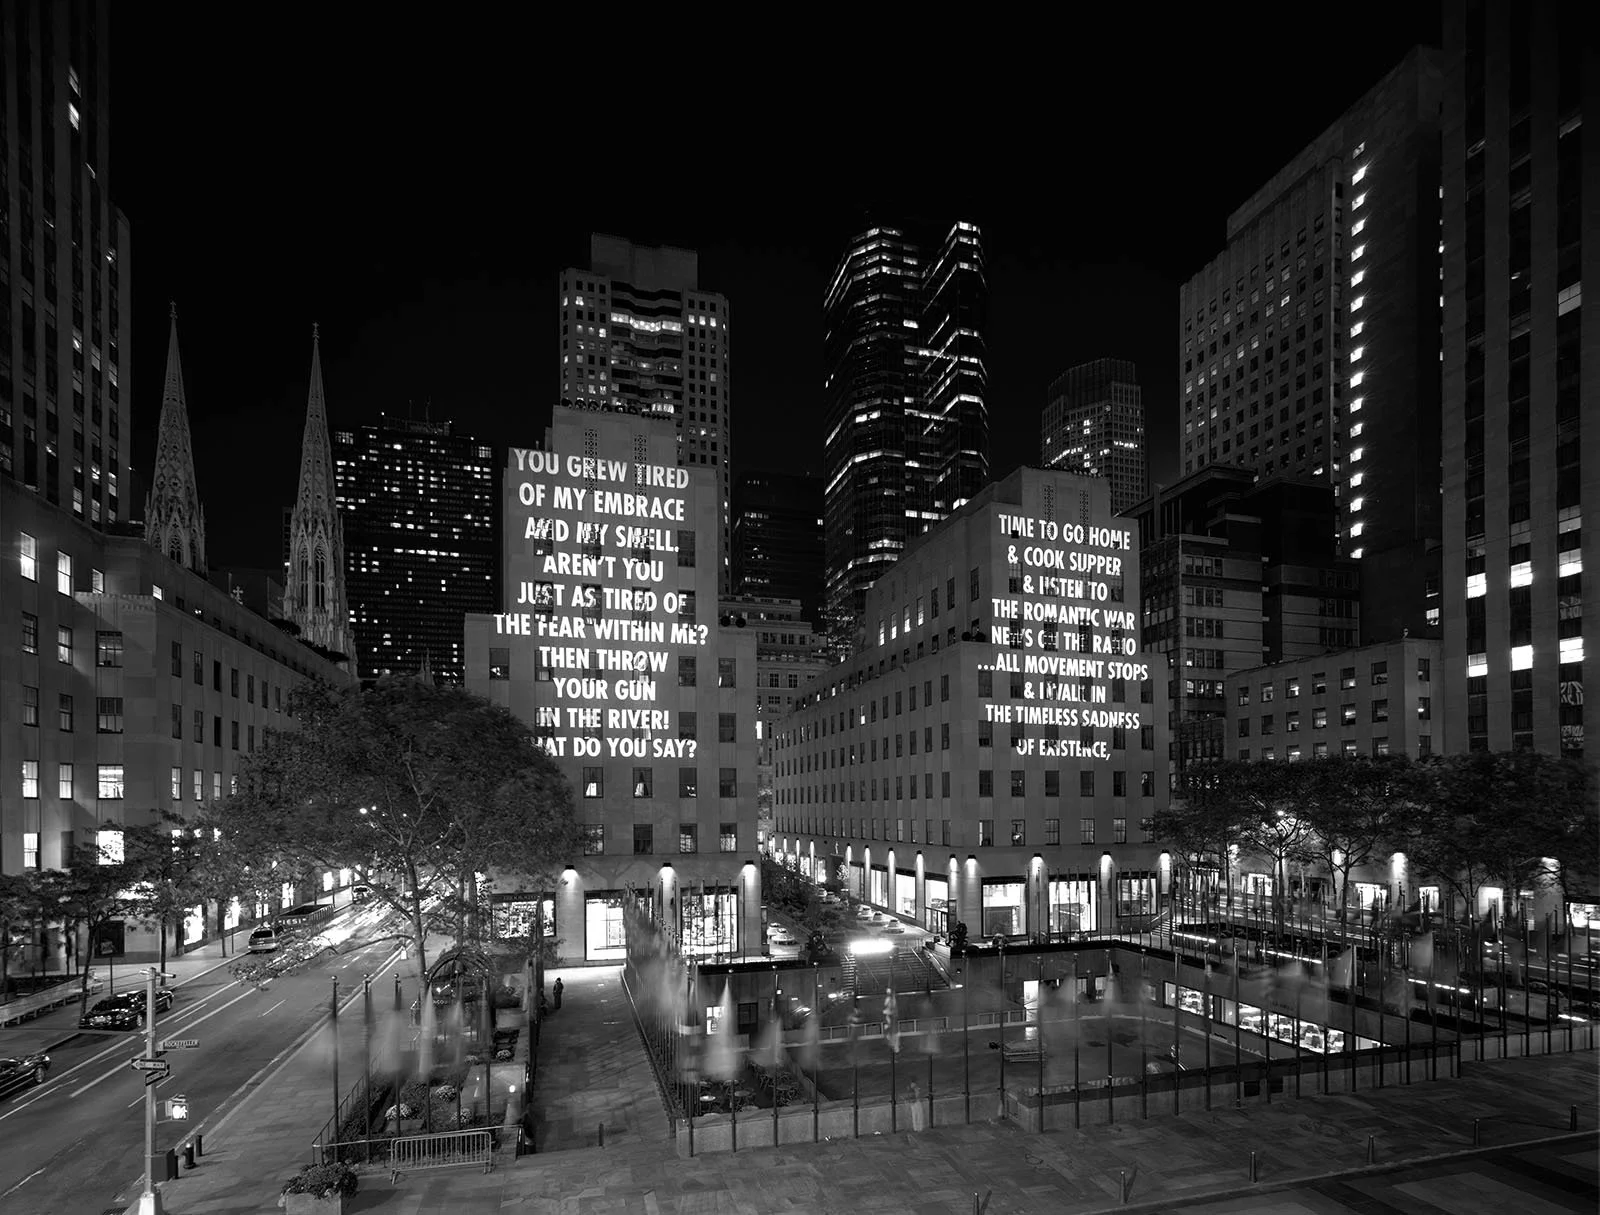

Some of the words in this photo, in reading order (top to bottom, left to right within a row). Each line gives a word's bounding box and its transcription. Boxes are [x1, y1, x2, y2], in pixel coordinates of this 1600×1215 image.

[514, 449, 559, 475] YOU
[567, 455, 628, 482] GREW
[634, 463, 689, 489] TIRED
[519, 482, 546, 506] OF
[553, 486, 587, 511] MY
[594, 490, 685, 521] EMBRACE
[524, 517, 569, 542] AND
[576, 521, 609, 545] MY
[615, 525, 680, 553] SMELL.
[998, 514, 1034, 538] TIME
[1039, 519, 1058, 541] TO
[1063, 523, 1084, 544] GO
[1089, 527, 1131, 550] HOME
[543, 552, 616, 578] AREN'T
[622, 557, 664, 582] YOU
[1007, 545, 1019, 564] &
[1024, 546, 1065, 570] COOK
[1069, 552, 1122, 576] SUPPER
[517, 581, 565, 606] JUST
[571, 585, 597, 608] AS
[603, 587, 657, 612] TIRED
[663, 592, 687, 614] OF
[1023, 574, 1035, 594] &
[1088, 581, 1108, 602] TO
[991, 598, 1019, 619] THE
[1023, 601, 1100, 627] ROMANTIC
[1103, 609, 1135, 630] WAR
[493, 612, 531, 635] THE
[537, 614, 586, 638] FEAR
[593, 618, 664, 643] WITHIN
[670, 623, 709, 645] ME?
[1063, 631, 1087, 652] TH
[539, 646, 590, 670] THEN
[596, 649, 669, 673] THROW
[977, 653, 1020, 673] ...ALL
[1025, 655, 1104, 678] MOVEMENT
[1108, 662, 1148, 681] STOPS
[552, 677, 609, 700] YOUR
[615, 679, 656, 701] GUN
[1023, 681, 1035, 699] &
[1039, 681, 1044, 700] I
[1091, 685, 1106, 704] IN
[539, 706, 561, 728] IN
[566, 708, 602, 728] THE
[608, 708, 670, 730] RIVER!
[985, 704, 1012, 723] THE
[1015, 706, 1078, 727] TIMELESS
[1082, 709, 1140, 729] SADNESS
[573, 736, 601, 758] DO
[606, 737, 647, 758] YOU
[652, 738, 697, 759] SAY?
[1016, 738, 1035, 755] OF
[1039, 738, 1111, 760] EXISTENCE,
